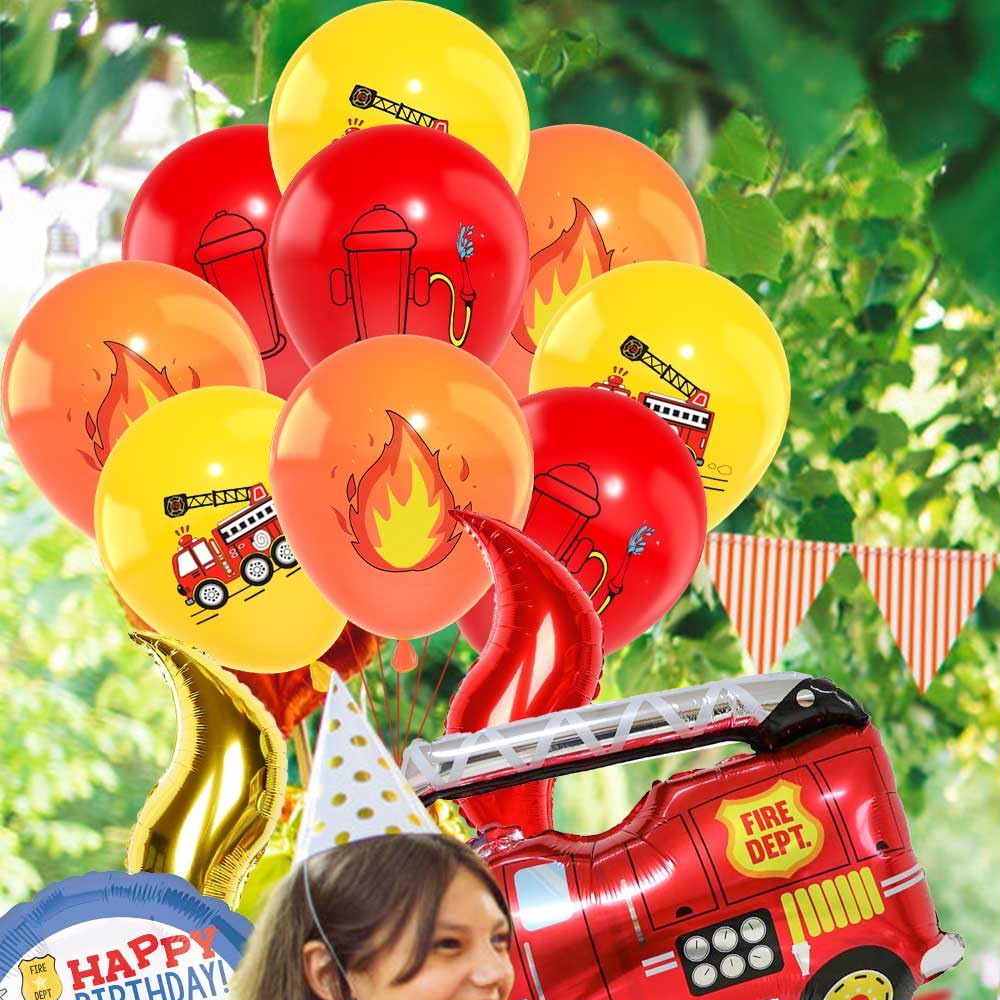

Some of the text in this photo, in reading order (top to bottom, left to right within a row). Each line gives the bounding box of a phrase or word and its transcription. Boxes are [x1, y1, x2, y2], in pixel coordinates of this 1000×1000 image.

[740, 800, 794, 835] FIRE
[745, 823, 812, 865] DEPT.
[29, 964, 48, 975] FIRE
[67, 926, 217, 991] HAPPY
[34, 988, 52, 1000] DEPT
